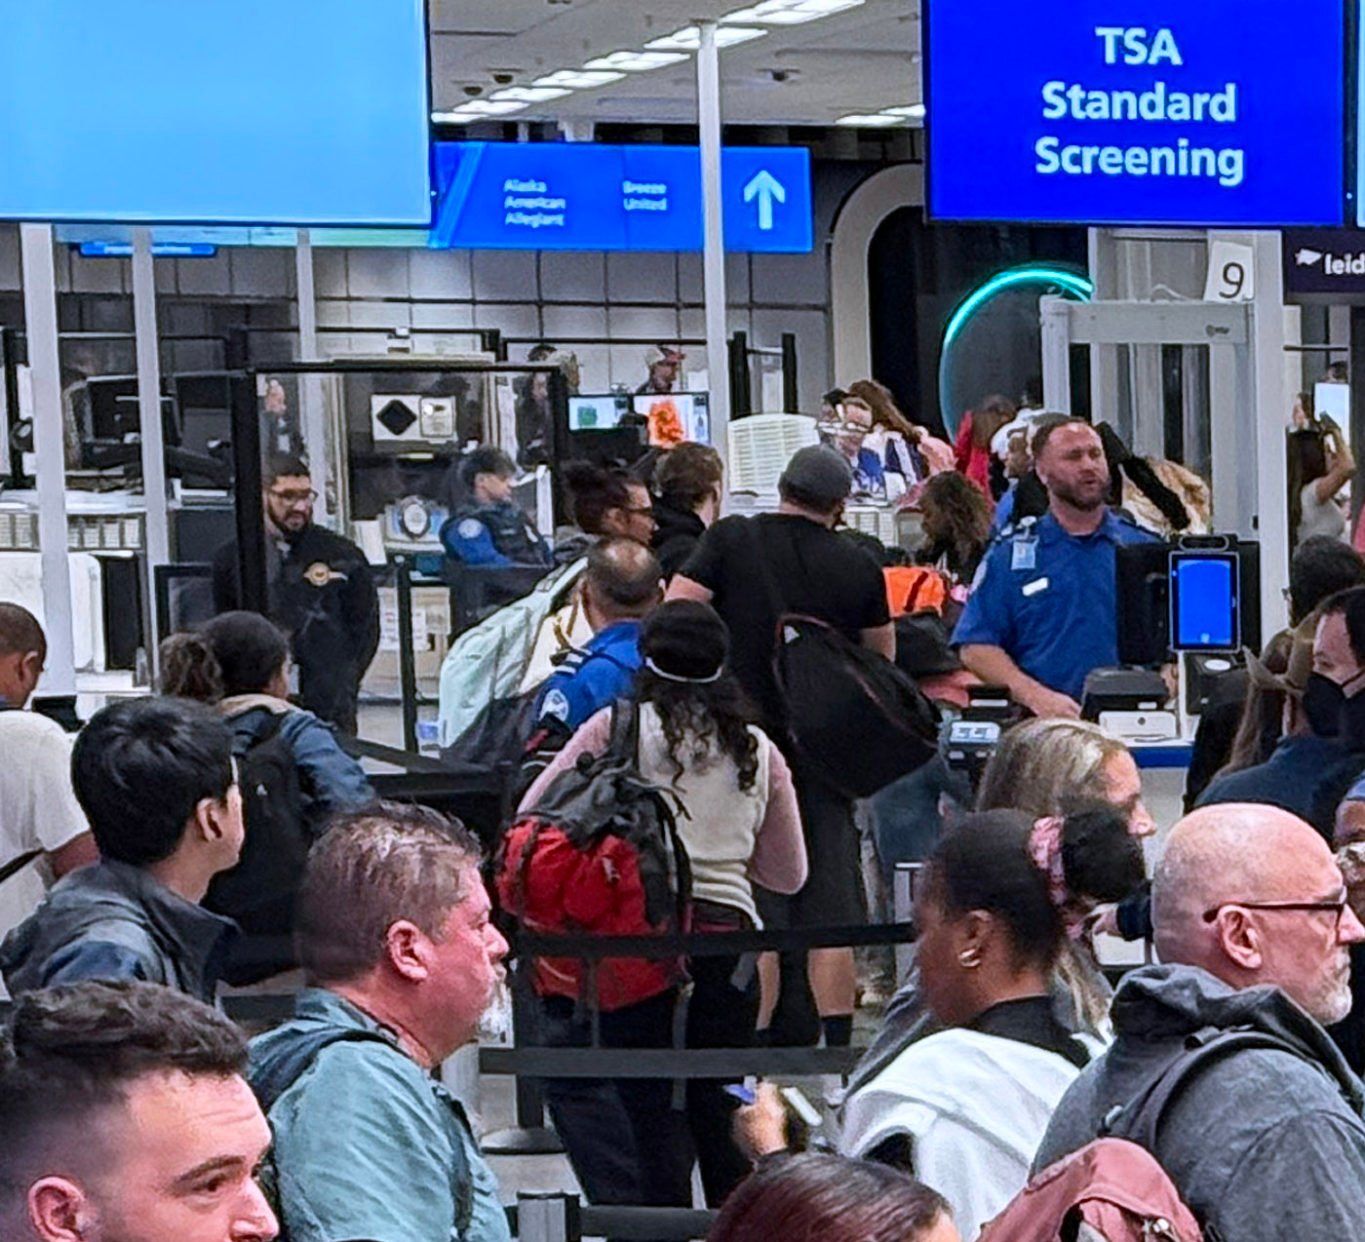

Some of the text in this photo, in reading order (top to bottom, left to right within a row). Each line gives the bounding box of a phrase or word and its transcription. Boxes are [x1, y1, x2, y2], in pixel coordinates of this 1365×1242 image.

[1095, 27, 1183, 65] TSA
[1042, 82, 1237, 122] Standard
[1035, 137, 1244, 186] Screening
[1218, 262, 1245, 299] 9
